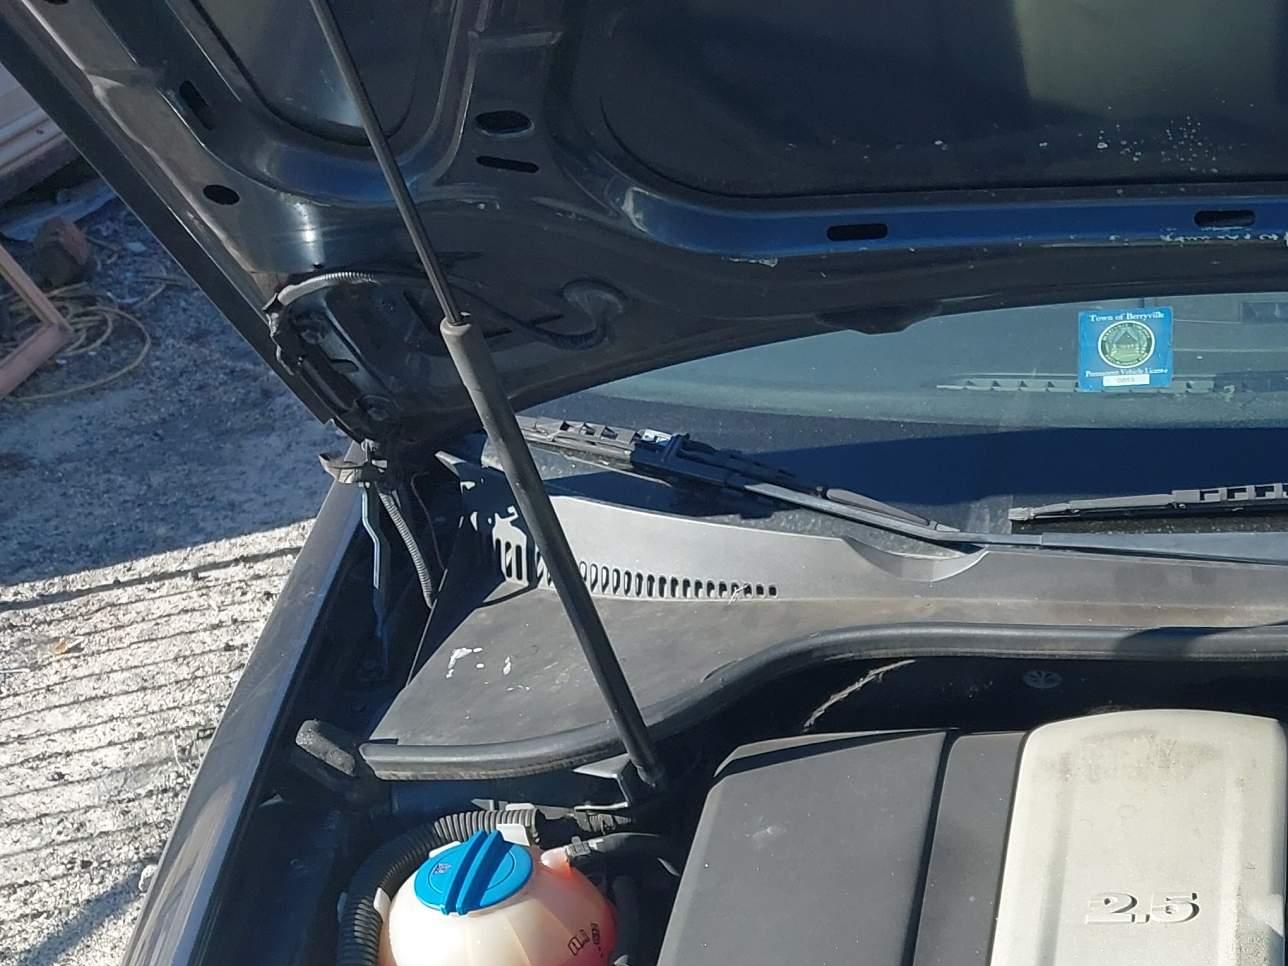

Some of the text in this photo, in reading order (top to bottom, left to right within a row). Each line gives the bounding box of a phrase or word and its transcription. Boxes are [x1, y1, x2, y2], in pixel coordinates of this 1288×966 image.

[1089, 314, 1114, 322] Town
[1126, 311, 1164, 321] Berryville
[1085, 892, 1200, 924] 2.5
